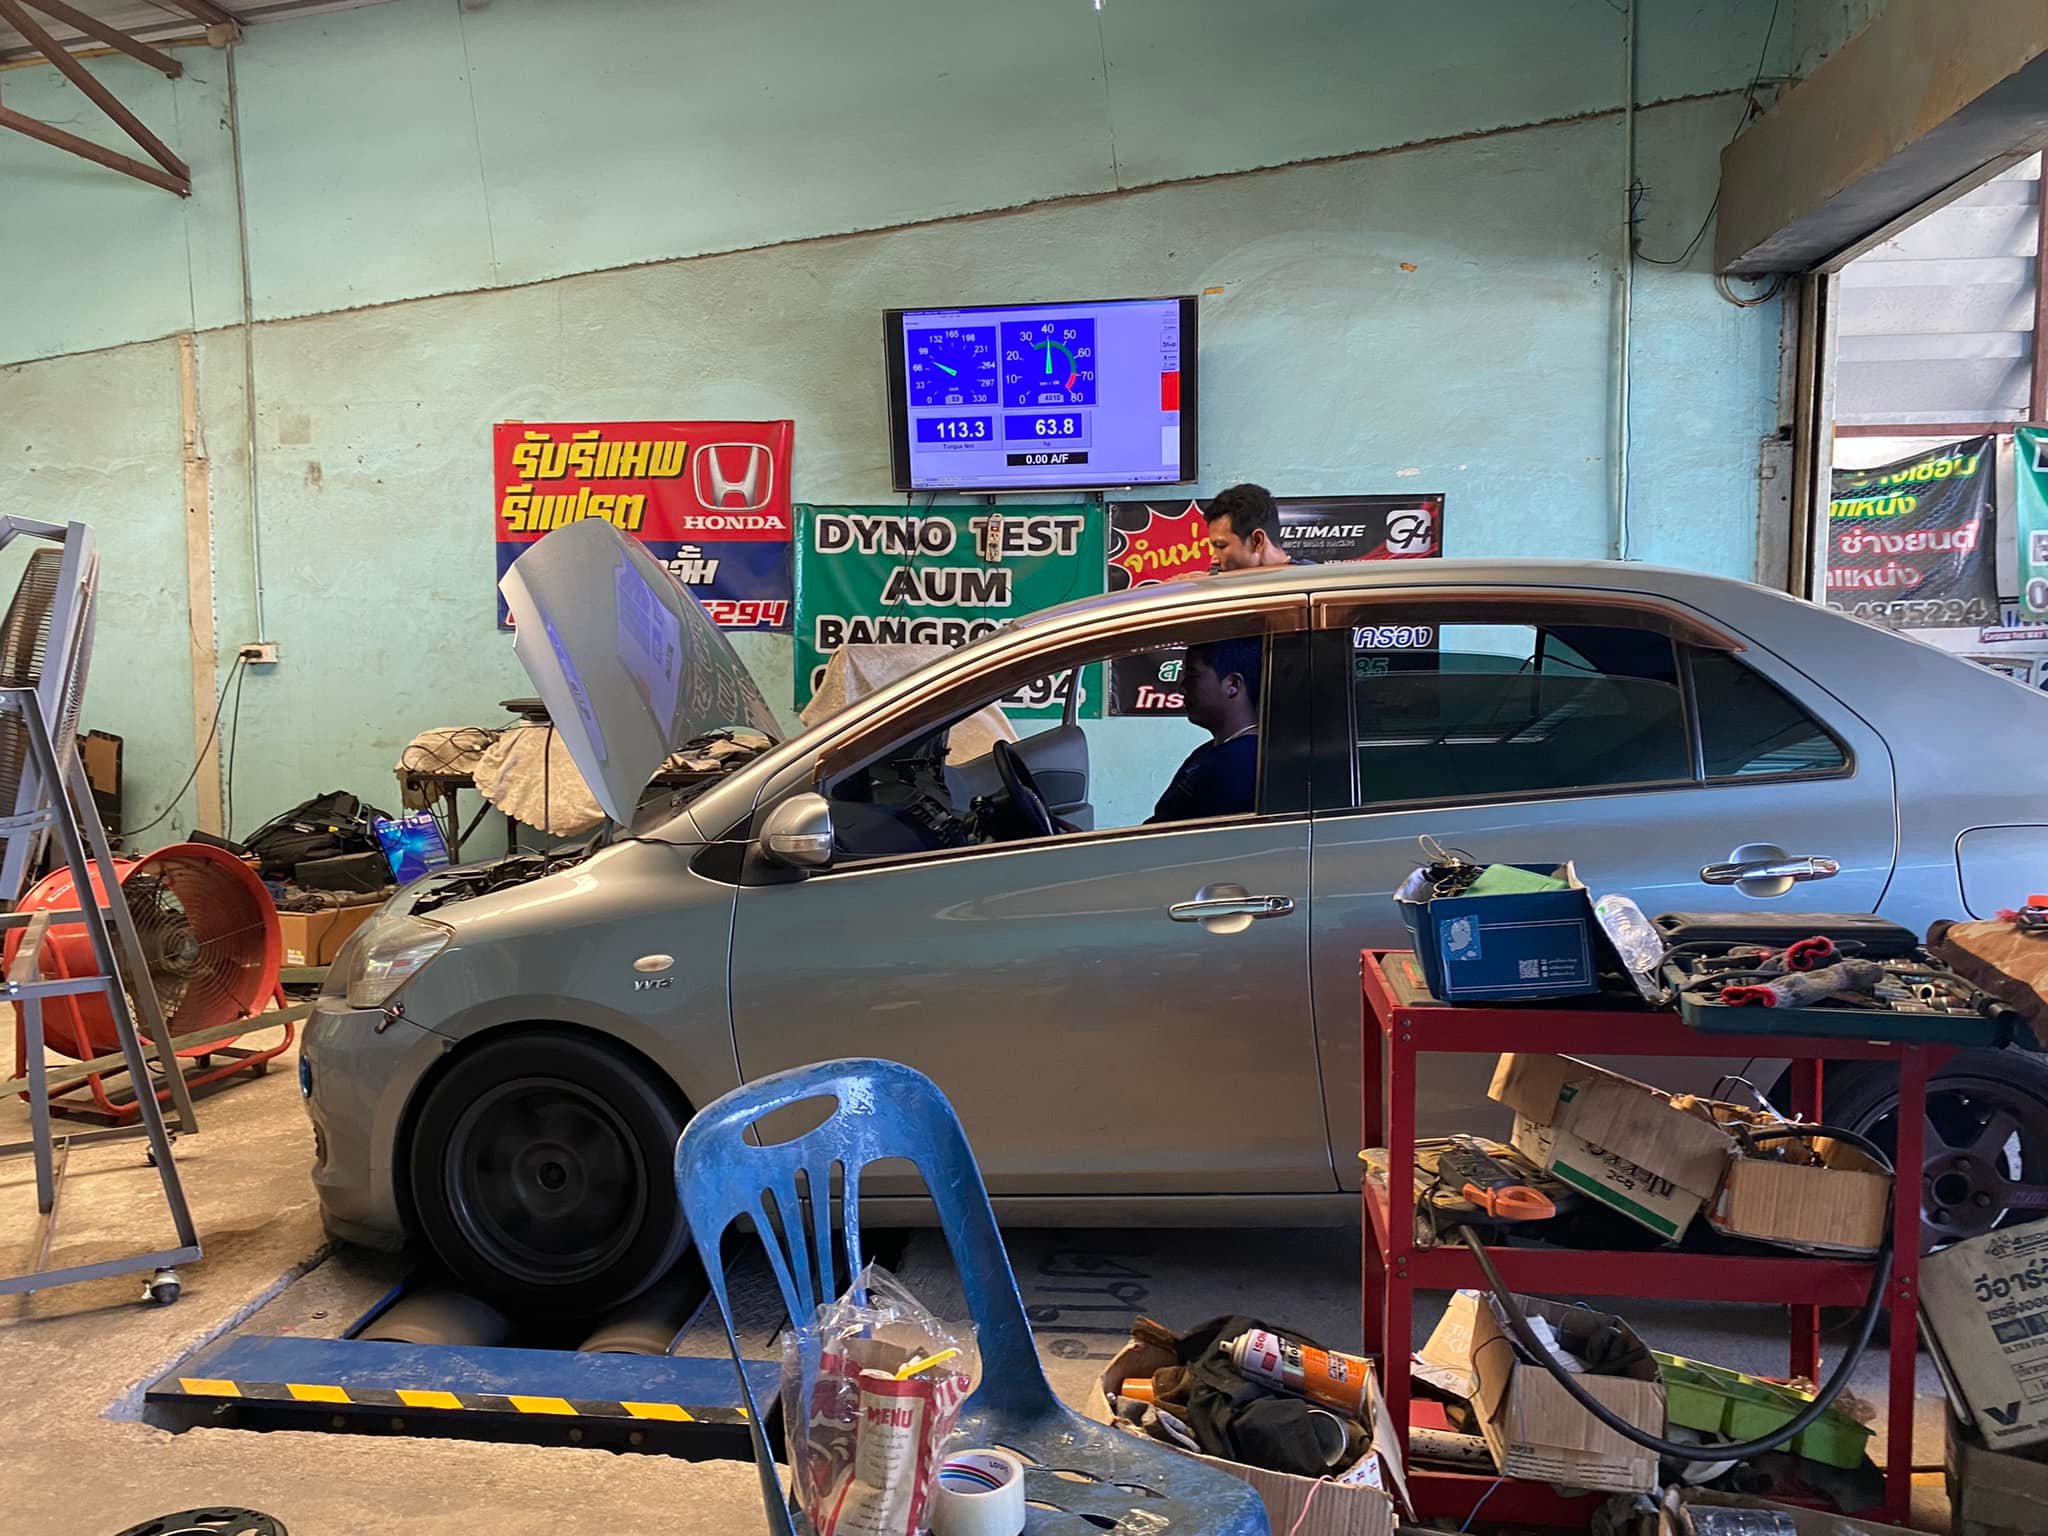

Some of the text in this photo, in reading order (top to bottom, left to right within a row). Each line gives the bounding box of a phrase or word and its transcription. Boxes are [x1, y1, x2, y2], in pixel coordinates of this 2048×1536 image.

[945, 330, 959, 338] 165
[1041, 323, 1054, 334] 40
[1019, 331, 1032, 342] 30
[1063, 329, 1076, 340] 50
[974, 345, 988, 353] 231
[1077, 347, 1091, 358] 60
[1006, 350, 1019, 361] 20
[1006, 374, 1017, 384] 10
[1081, 371, 1094, 381] 70
[926, 396, 933, 404] 0
[1019, 394, 1026, 405] 0
[1070, 392, 1083, 402] 80
[936, 421, 986, 439] 113.3
[1035, 418, 1075, 436] 63.8
[1026, 453, 1069, 465] 0.00 A/F
[683, 515, 786, 530] HONDA
[815, 514, 1084, 555] DYNO TEST
[1123, 522, 1215, 573] จำหน่า
[880, 567, 1011, 607] AUM
[700, 600, 788, 627] 294
[816, 615, 1012, 653] BANGBO
[866, 1406, 914, 1429] MENU
